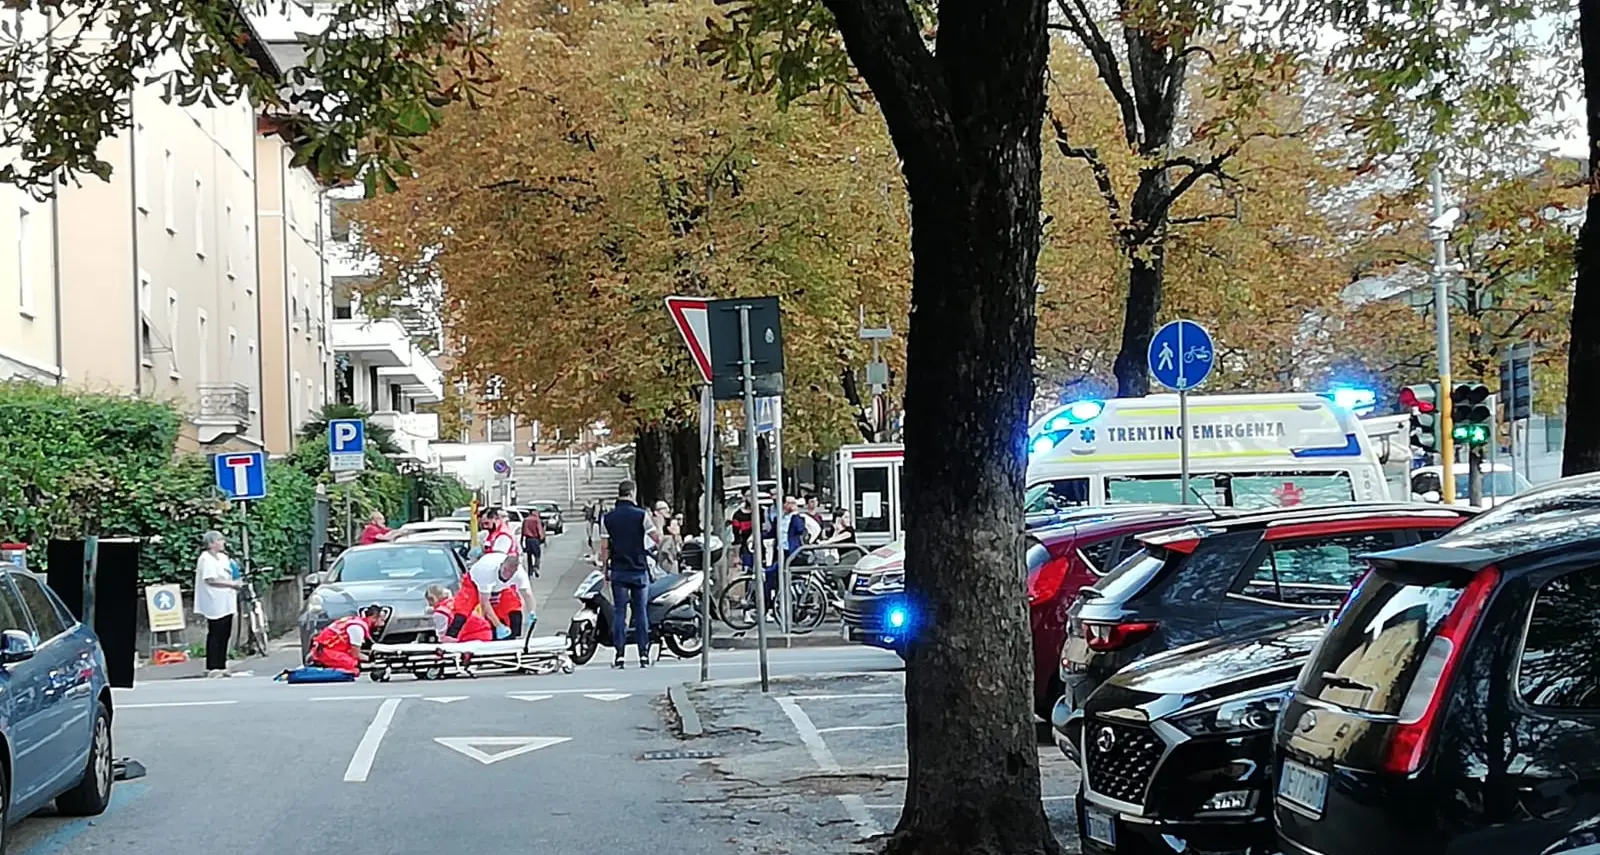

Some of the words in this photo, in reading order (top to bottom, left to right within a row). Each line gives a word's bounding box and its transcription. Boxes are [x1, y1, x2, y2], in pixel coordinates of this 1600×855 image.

[335, 423, 357, 450] P
[1108, 426, 1184, 442] TRENTINO
[1192, 422, 1286, 440] EMERGENZA
